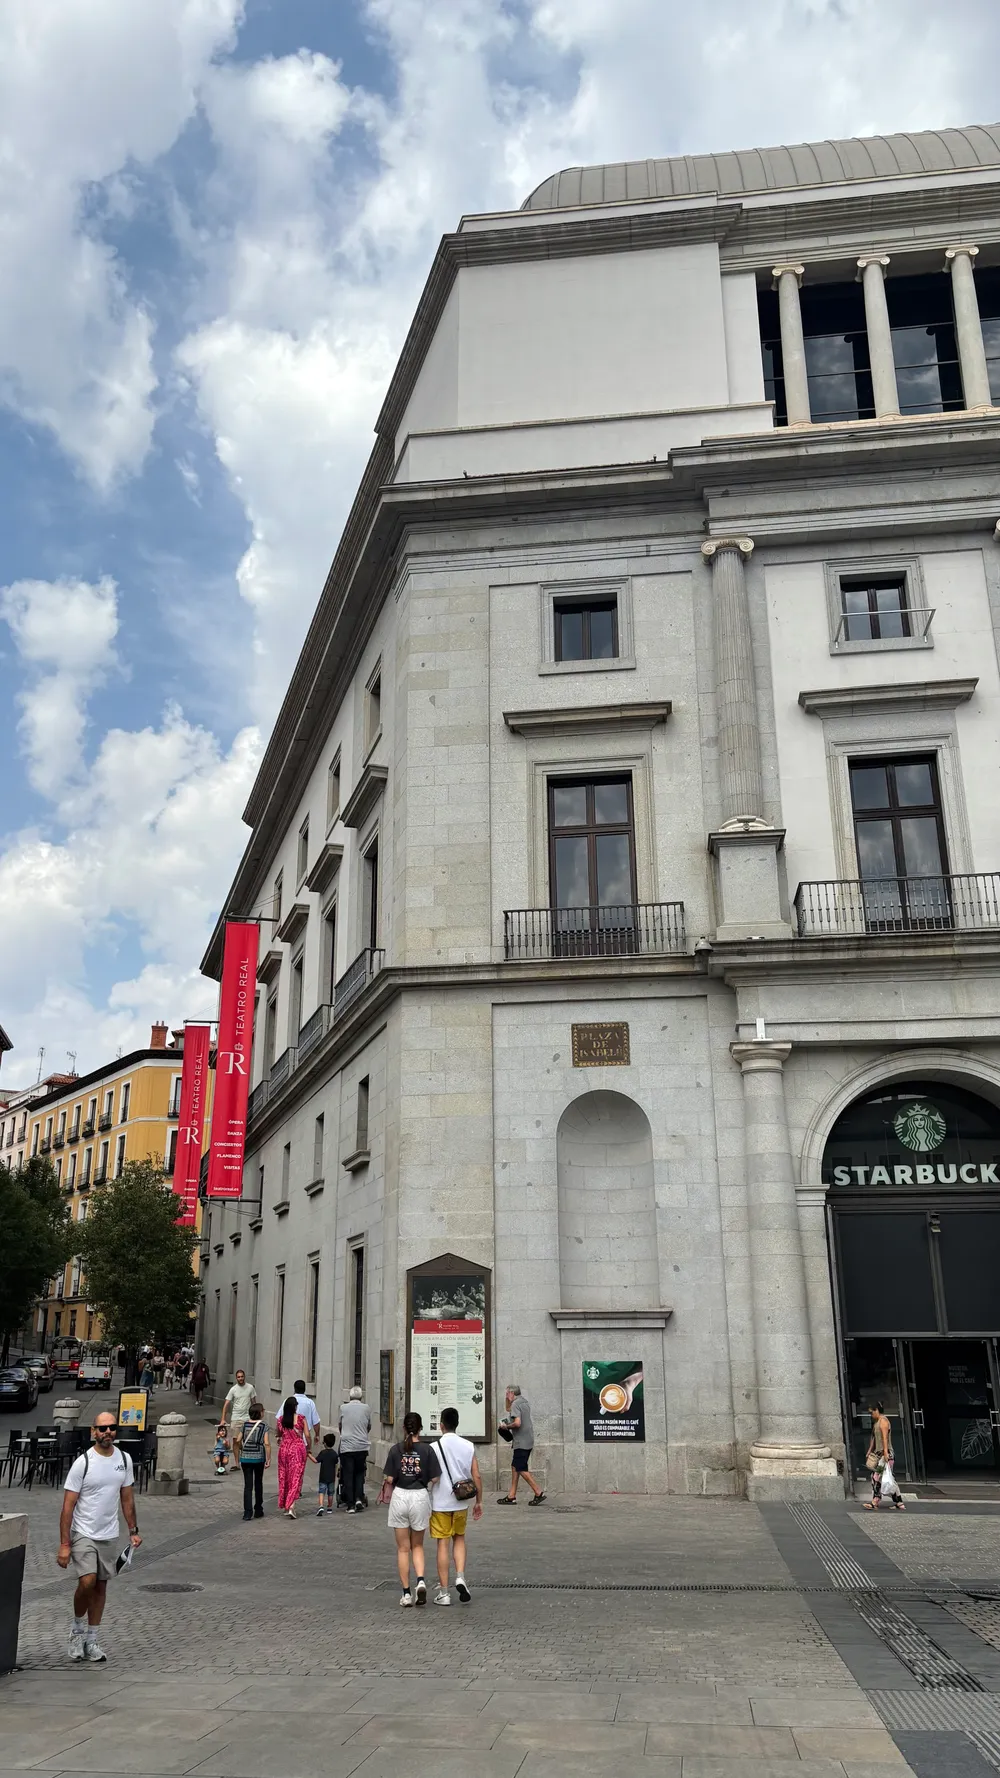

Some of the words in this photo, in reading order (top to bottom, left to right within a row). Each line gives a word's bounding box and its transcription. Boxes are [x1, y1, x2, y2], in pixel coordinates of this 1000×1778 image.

[239, 957, 249, 987] REAL
[235, 991, 247, 1036] TEATRO
[580, 1032, 619, 1040] PLAZA
[592, 1040, 608, 1048] DE
[195, 1052, 203, 1077] REAL
[191, 1079, 202, 1114] TEATRO
[833, 1163, 1000, 1186] STARBUCK
